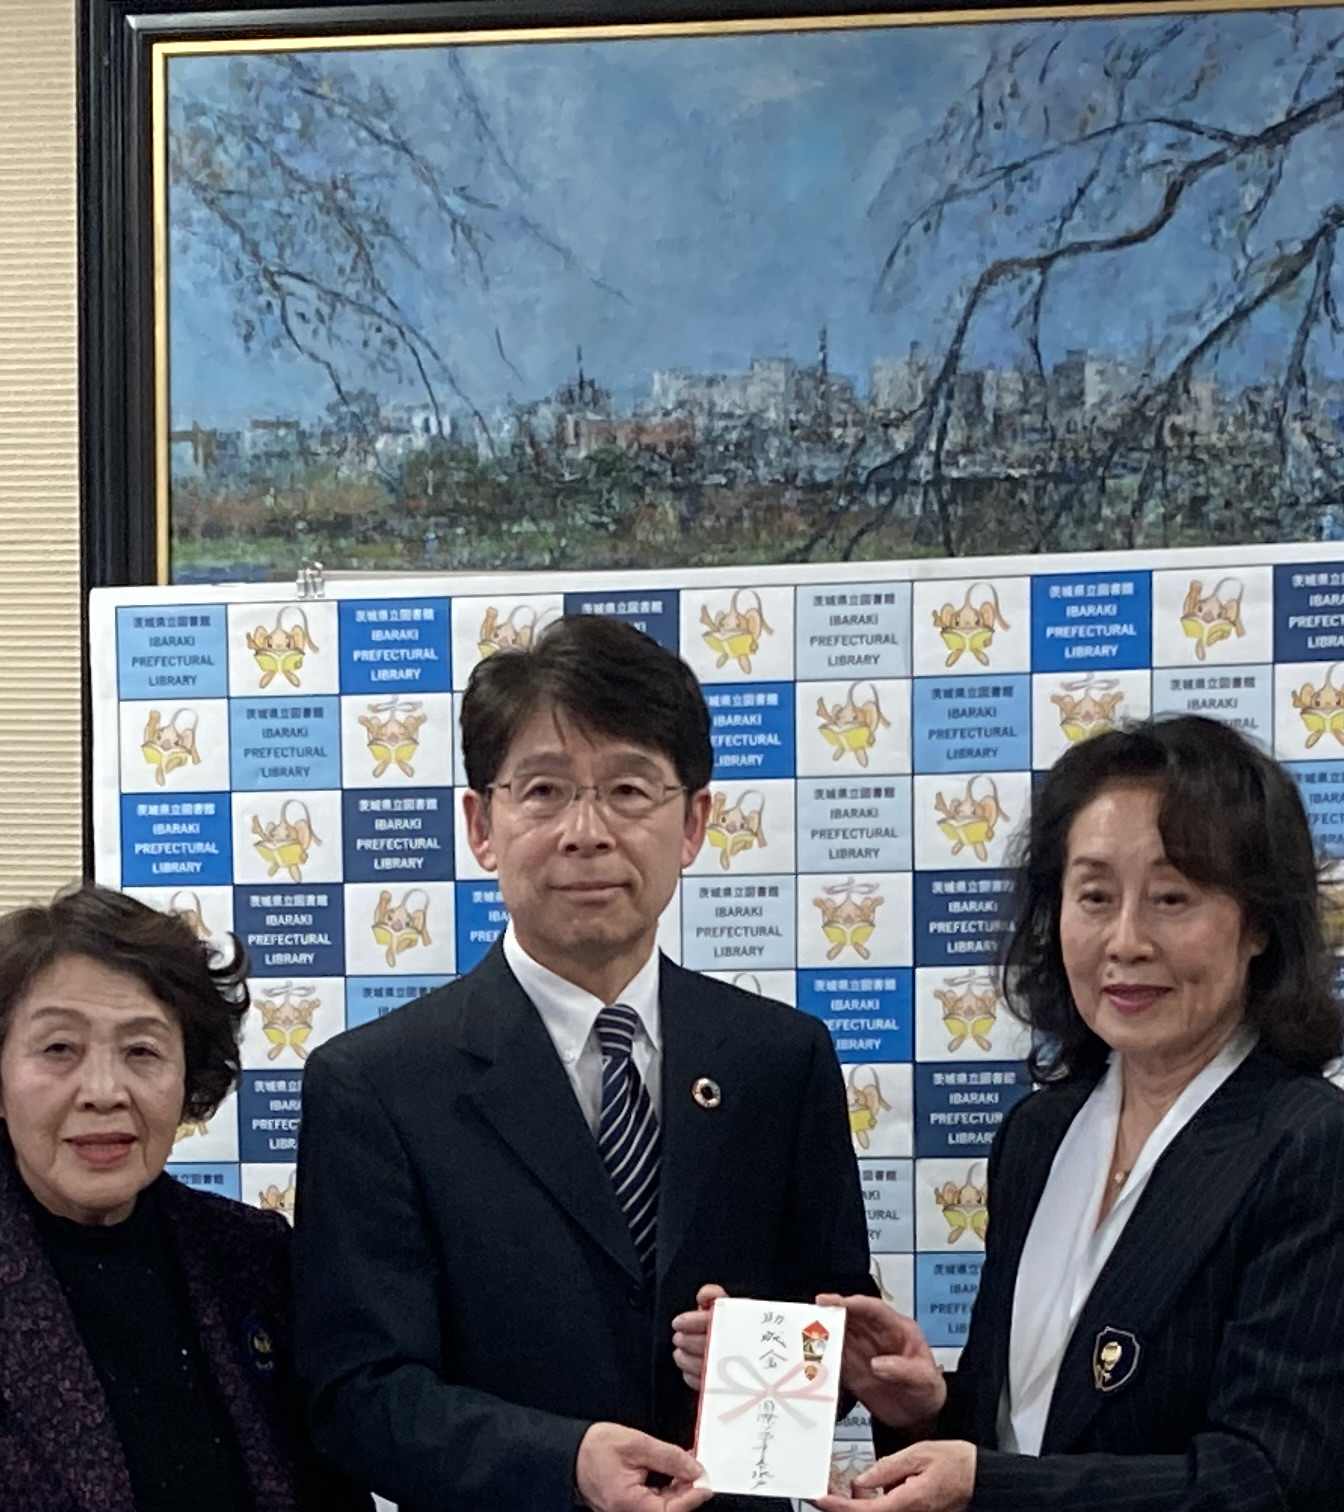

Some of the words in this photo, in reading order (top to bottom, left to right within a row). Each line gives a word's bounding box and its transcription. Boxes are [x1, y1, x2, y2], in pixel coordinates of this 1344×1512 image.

[1050, 582, 1134, 597] 茨城県立図書館
[814, 592, 895, 607] 茨城県立図書館
[583, 600, 662, 615] 茨城県立図書館
[1067, 604, 1117, 617] IBARAKI
[356, 608, 434, 622] 茨城県立図書館
[830, 613, 878, 626] IBARAKI
[134, 615, 210, 629] 茨城県立図書館
[372, 629, 418, 641] IBARAKI
[1047, 623, 1137, 638] PREFECTURAL
[149, 635, 195, 647] IBARAKI
[810, 633, 899, 647] PREFECTURAL
[354, 647, 438, 662] PREFECTURAL
[1065, 645, 1118, 658] LIBRARY
[132, 654, 214, 668] PREFECTURAL
[828, 654, 880, 667] LIBRARY
[149, 674, 197, 686] LIBRARY
[371, 668, 421, 681] LIBRARY
[1171, 676, 1255, 690] 茨城県立図書館
[931, 685, 1014, 700] 茨城県立図書館
[709, 693, 778, 707] 城県立図書館
[1187, 697, 1238, 710] IBARAKI
[247, 706, 324, 720] 茨城県立図書館
[948, 706, 997, 719] IBARAKI
[713, 714, 762, 726] IBARAKI
[262, 727, 308, 739] IBARAKI
[928, 726, 1017, 740] PREFECTURAL
[711, 733, 782, 747] EFECTURAL
[245, 745, 328, 759] PREFECTURAL
[946, 747, 999, 760] LIBRARY
[712, 754, 764, 766] LIBRARY
[262, 766, 311, 778] LIBRARY
[814, 786, 895, 800] 茨城県立図書館
[138, 803, 214, 816] 茨城県立図書館
[359, 798, 437, 811] 茨城県立図書館
[830, 807, 879, 819] IBARAKI
[153, 823, 199, 834] IBARAKI
[375, 818, 421, 830] IBARAKI
[811, 827, 899, 840] PREFECTURAL
[136, 841, 218, 854] PREFECTURAL
[357, 837, 441, 850] PREFECTURAL
[829, 847, 881, 860] LIBRARY
[153, 861, 201, 873] LIBRARY
[374, 857, 424, 869] LIBRARY
[699, 885, 779, 898] 茨城県立図書館
[251, 894, 327, 907] 茨城県立図書館
[949, 900, 998, 912] IBARAKI
[715, 906, 763, 917] IBARAKI
[266, 914, 312, 926] IBARAKI
[696, 925, 783, 938] PREFECTURAL
[248, 933, 331, 946] PREFECTURAL
[714, 945, 765, 957] LIBRARY
[265, 953, 314, 965] LIBRARY
[815, 978, 896, 991] 茨城県立図書館
[831, 999, 879, 1010] IBARAKI
[934, 1072, 1015, 1085] 茨城県立図書館
[255, 1080, 301, 1092] 茨城県立
[950, 1093, 999, 1104] IBARAKI
